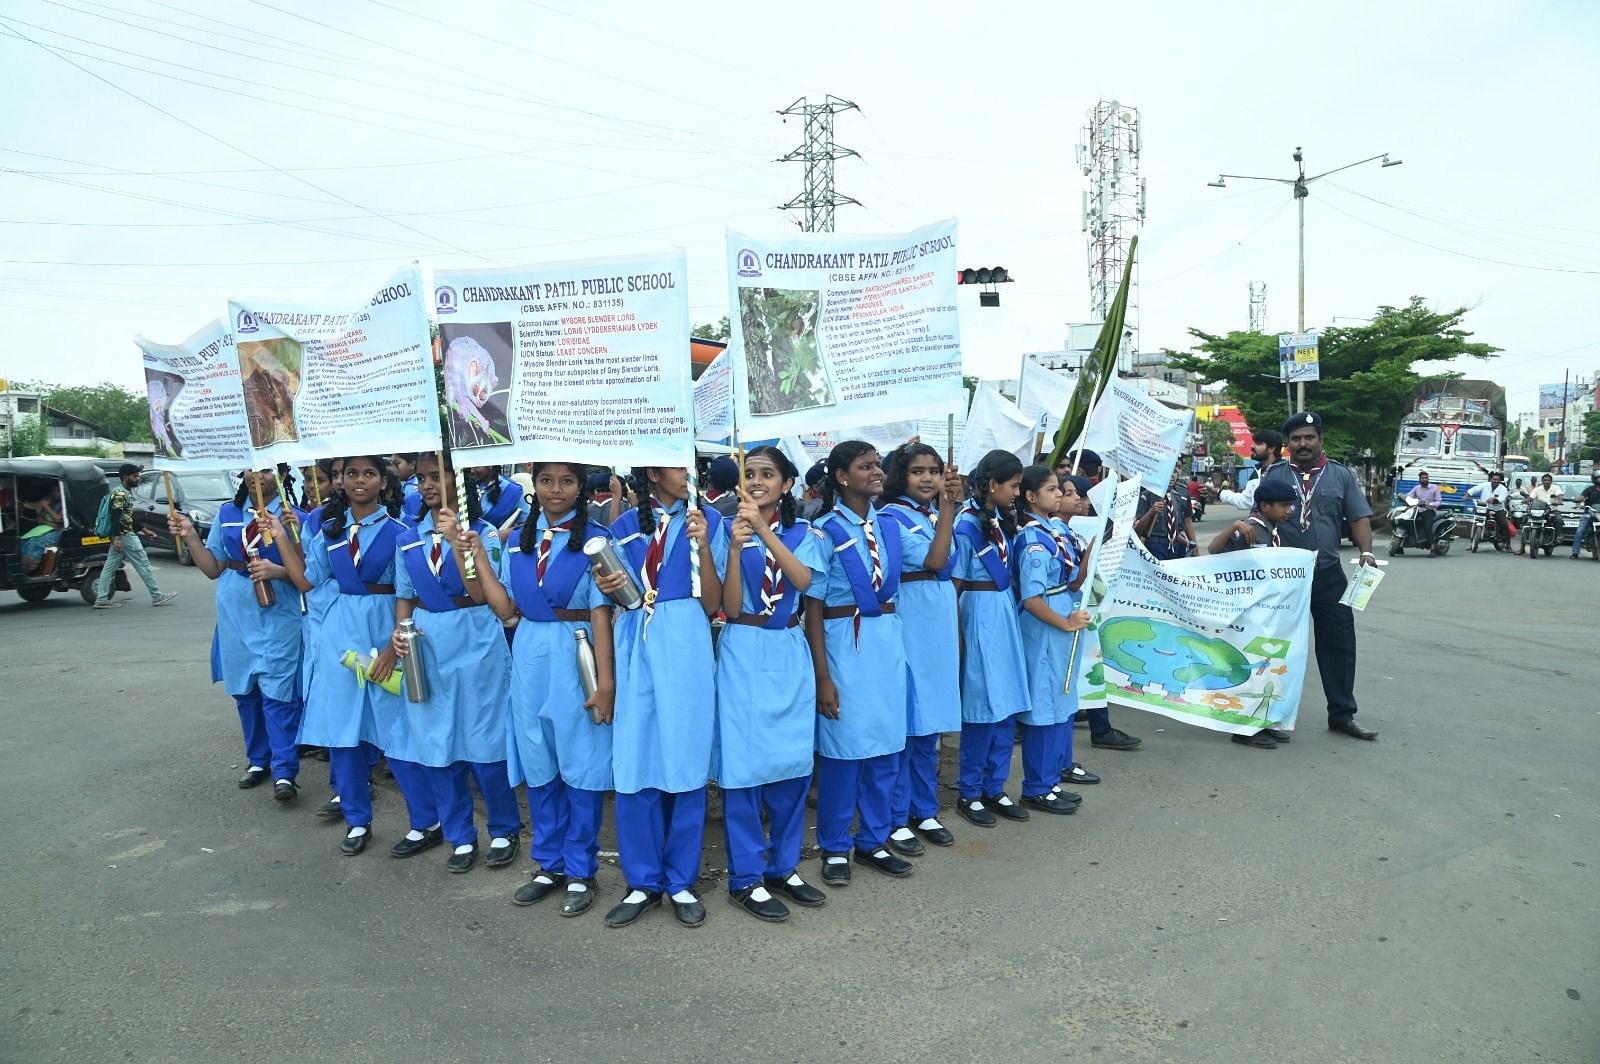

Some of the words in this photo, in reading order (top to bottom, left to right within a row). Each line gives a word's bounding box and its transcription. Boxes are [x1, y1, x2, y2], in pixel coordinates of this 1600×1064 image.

[765, 253, 855, 269] CHANDRAKANT
[858, 252, 889, 268] PATIL
[890, 244, 919, 266] PUBLIC
[919, 235, 955, 257] SCHOOL
[829, 273, 856, 283] (CBSE
[463, 283, 541, 303] CHANDRAKANT
[544, 281, 578, 299] PATIL
[581, 276, 624, 296] PUBLIC
[627, 272, 675, 292] SCHOOL
[521, 304, 545, 315] (CBSE
[547, 302, 571, 311] AFFN.
[593, 298, 624, 309] 831135)
[560, 316, 586, 325] MYSORE
[587, 314, 615, 324] SLENDER
[617, 313, 635, 322] LORIS
[563, 327, 582, 335] LORIS
[556, 348, 575, 356] LEAST
[577, 346, 608, 355] CONCERN
[1153, 569, 1179, 585] (CBSE
[1180, 580, 1205, 593] AFFN.
[1214, 569, 1266, 583] PUBLIC
[1270, 567, 1306, 579] SCHOOL
